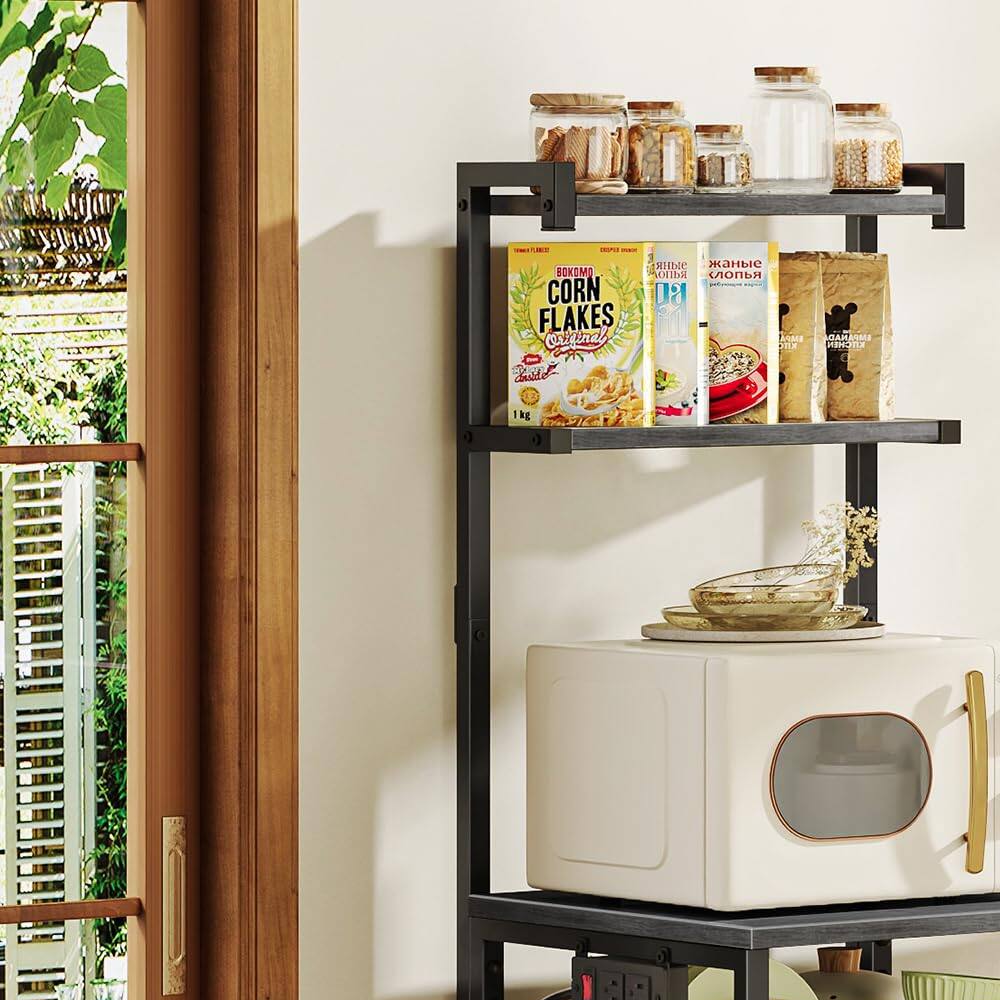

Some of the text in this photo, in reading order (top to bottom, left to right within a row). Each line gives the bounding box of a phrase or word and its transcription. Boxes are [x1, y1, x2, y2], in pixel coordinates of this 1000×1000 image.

[557, 267, 593, 277] BOKOMO
[548, 276, 600, 304] CORN
[540, 303, 614, 333] FLAKES
[545, 326, 608, 350] Original
[513, 410, 530, 421] 1 kg
